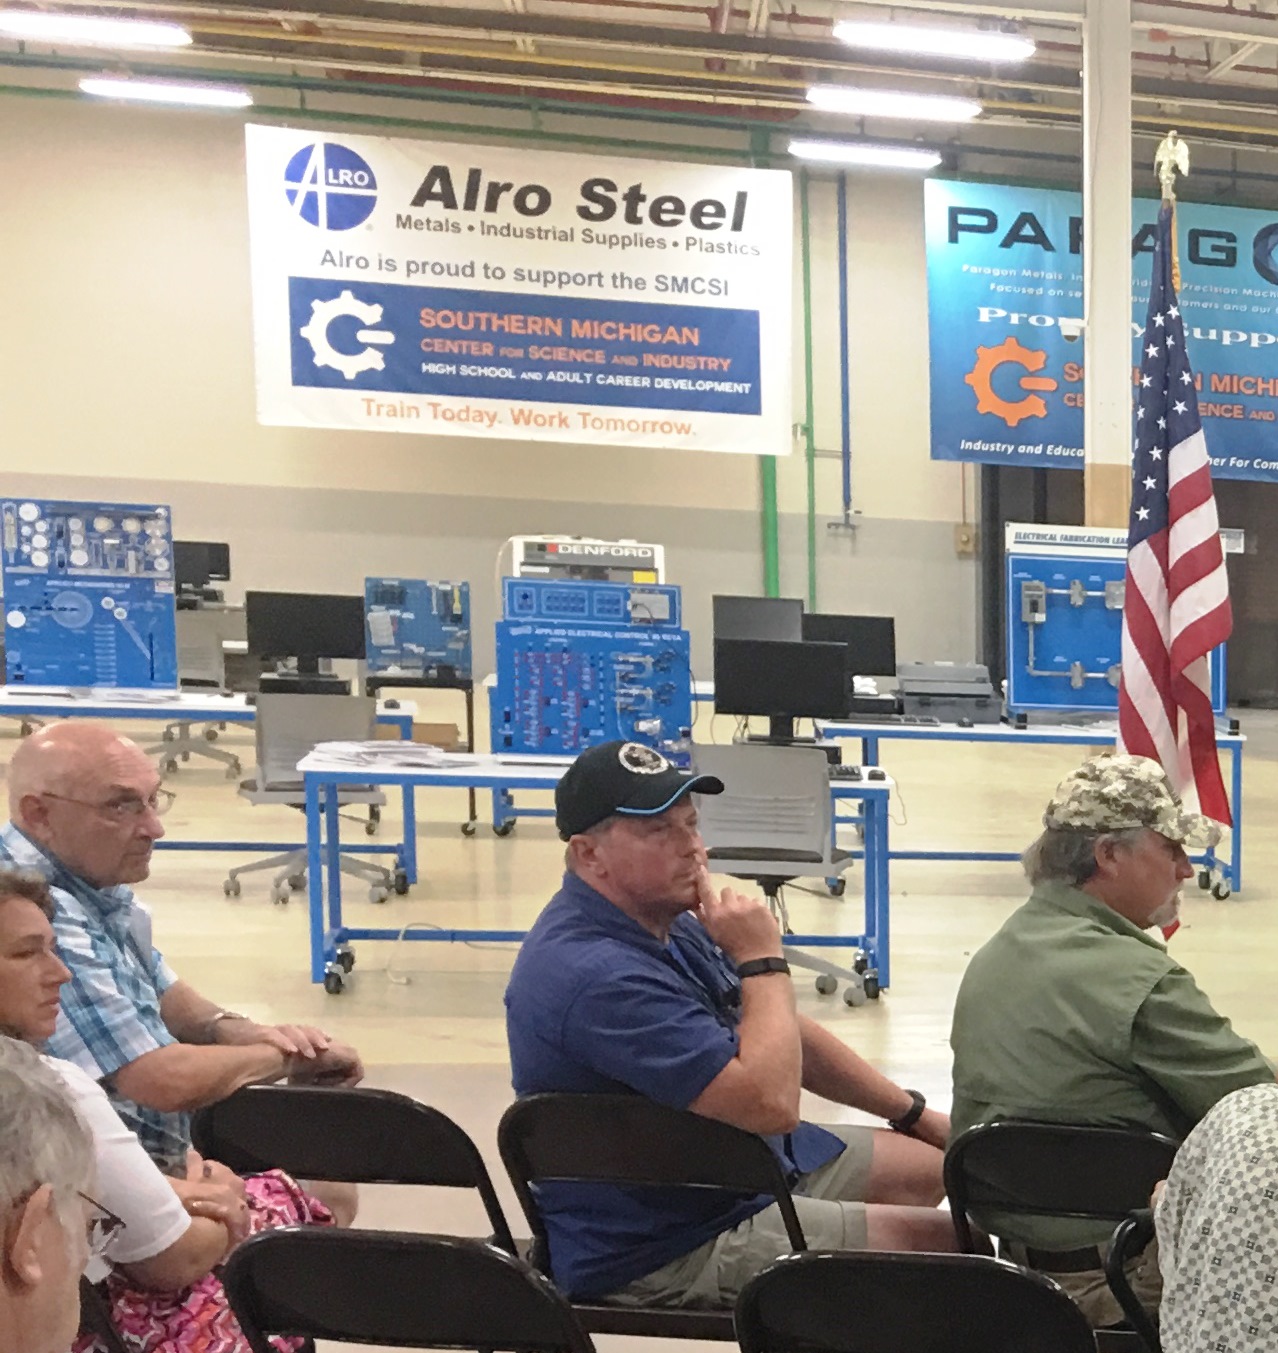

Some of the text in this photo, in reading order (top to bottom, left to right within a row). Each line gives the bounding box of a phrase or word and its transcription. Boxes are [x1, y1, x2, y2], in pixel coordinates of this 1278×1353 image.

[410, 165, 748, 232] Alro Steel
[396, 214, 760, 256] Metals Industrial Supplies Plastics
[320, 249, 729, 296] Alro is proud to support the SMCSI
[962, 263, 1016, 277] Paragon
[1021, 269, 1063, 280] Metals
[1182, 283, 1238, 295] Precision
[990, 282, 1044, 295] Focused
[1223, 302, 1248, 313] and
[419, 307, 700, 346] SOUTHERN MICHIGAN
[420, 338, 494, 357] CENTER
[528, 345, 606, 365] SCIENCE
[642, 353, 733, 372] INDUSTRY
[421, 362, 457, 375] HIGH
[459, 364, 516, 379] SCHOOL
[546, 371, 592, 384] ADULT
[596, 374, 651, 388] CAREER
[654, 377, 752, 395] DEVELOPMENT
[362, 398, 697, 436] Train Today. Work Tomorrow.
[1198, 402, 1244, 418] ENCE
[1250, 410, 1275, 421] AND
[960, 439, 1015, 455] Industry
[1018, 443, 1043, 455] and
[1046, 443, 1085, 457] Educa
[1229, 456, 1250, 468] For
[558, 544, 652, 558] DENFORD
[1015, 531, 1058, 542] ELECTRICAL
[1060, 534, 1110, 544] FABRICATION
